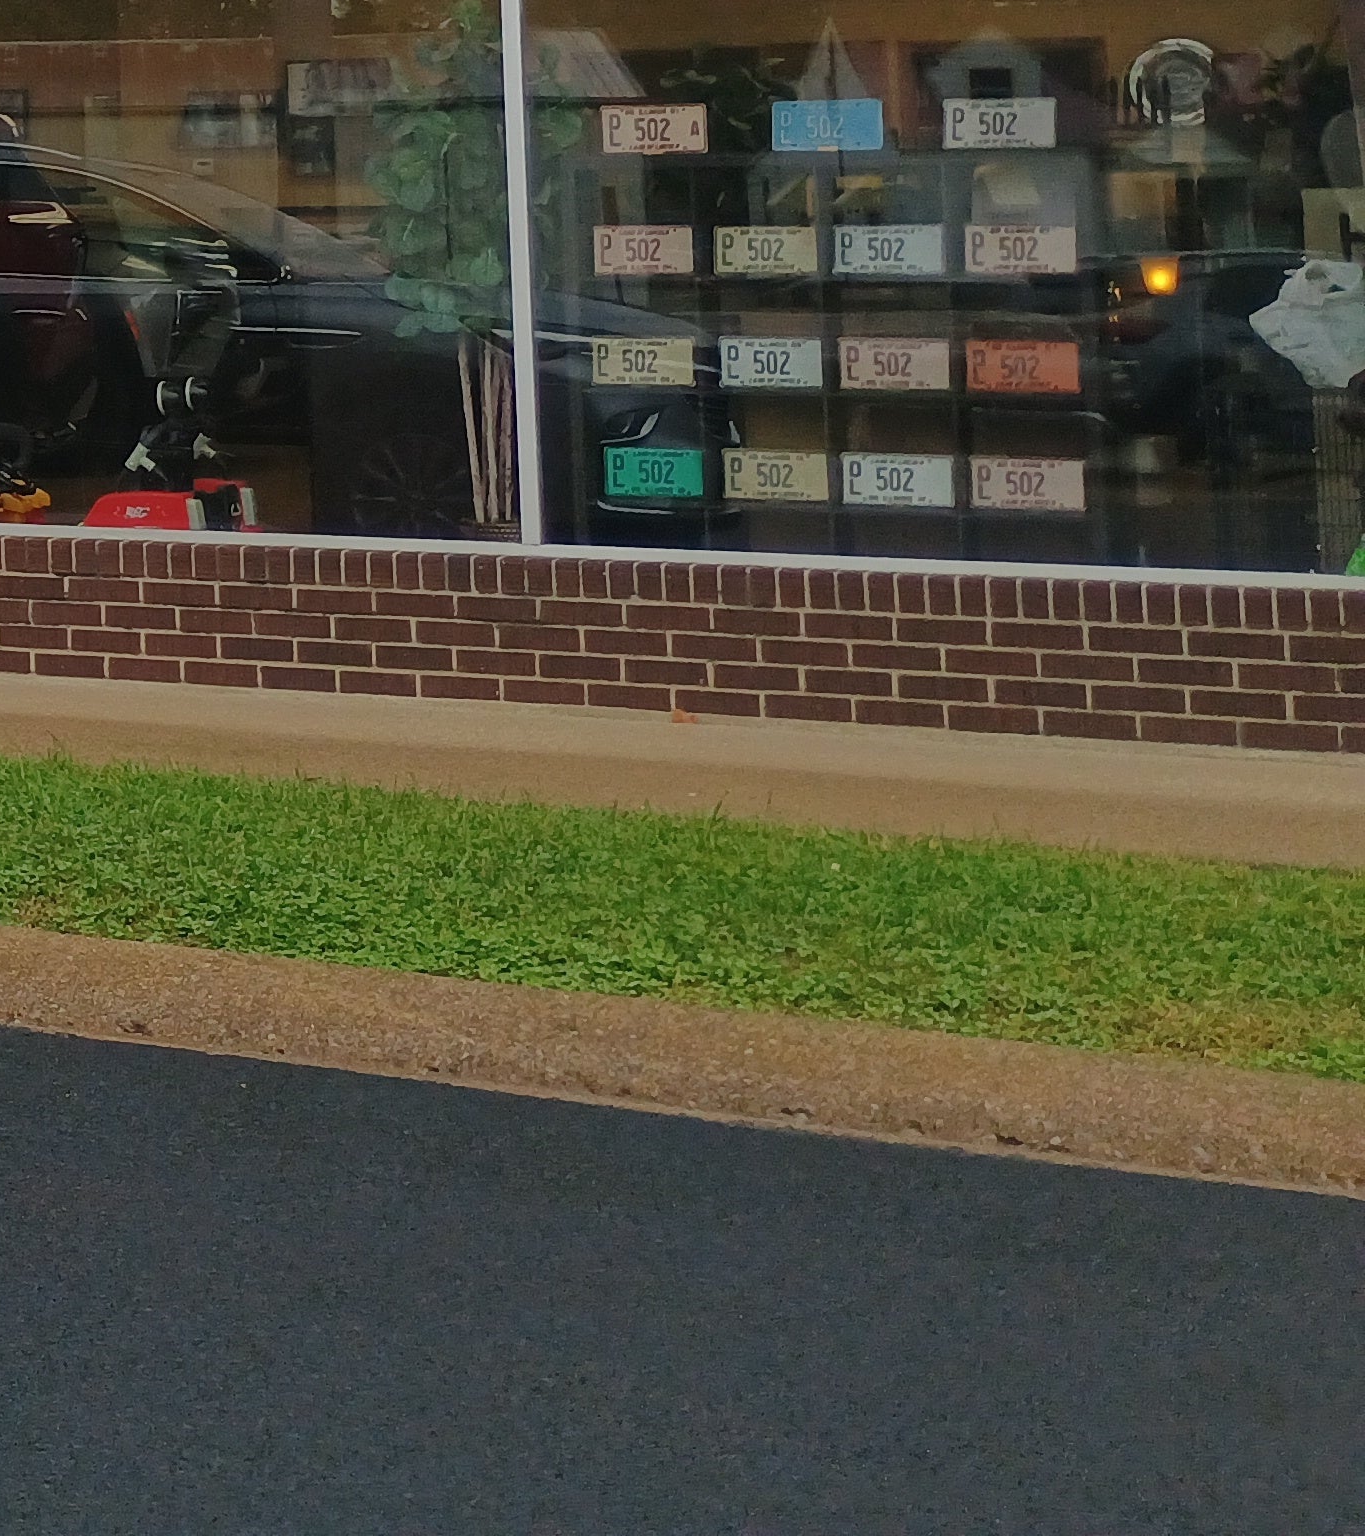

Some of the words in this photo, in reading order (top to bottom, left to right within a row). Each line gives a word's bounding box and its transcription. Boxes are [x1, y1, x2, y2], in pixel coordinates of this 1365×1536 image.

[634, 118, 670, 141] 502
[691, 120, 699, 136] A
[807, 116, 843, 138] 502
[979, 112, 1017, 135] 502
[625, 238, 661, 262] 502
[748, 238, 784, 261] 502
[868, 237, 904, 261] 502
[999, 236, 1038, 261] 502
[622, 349, 658, 373] 502
[754, 350, 790, 375] 502
[874, 352, 911, 377] 502
[1001, 355, 1039, 380] 502
[639, 460, 674, 484] 502
[757, 462, 793, 488] 502
[876, 467, 914, 492] 502
[1006, 471, 1045, 496] 502
